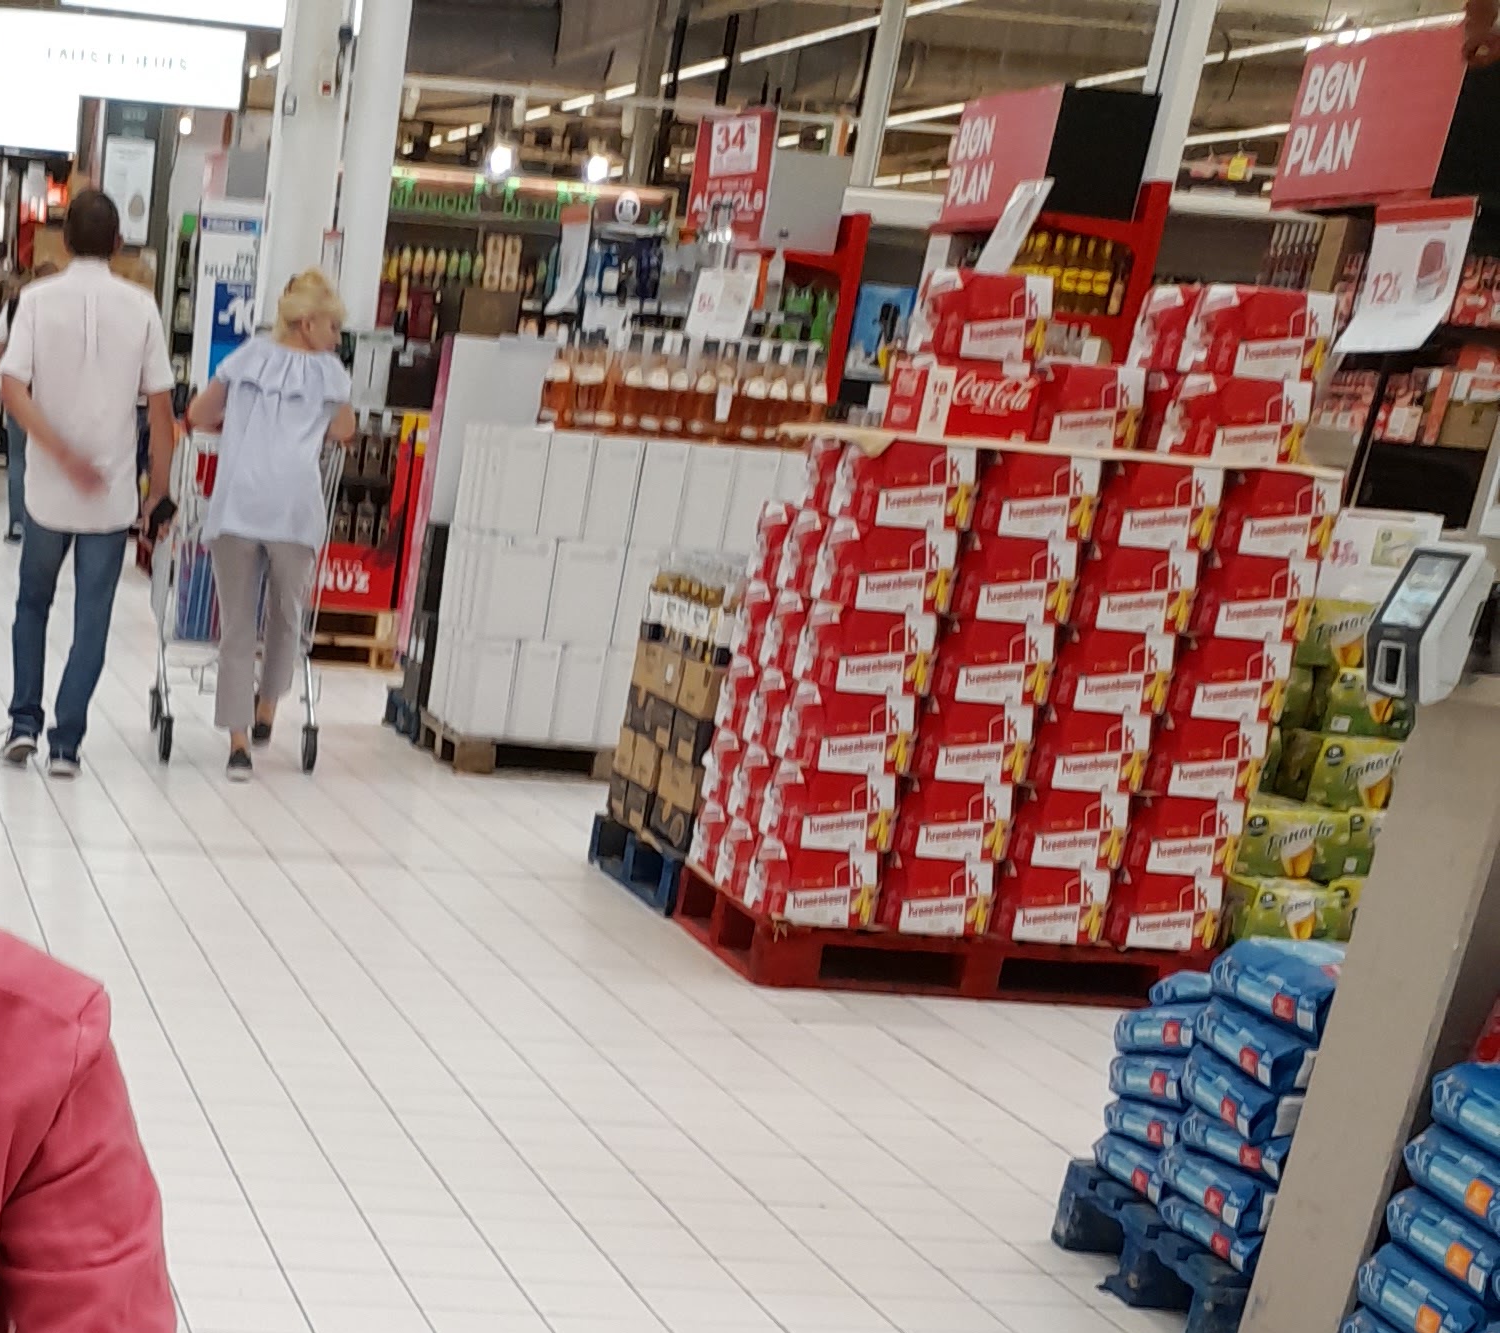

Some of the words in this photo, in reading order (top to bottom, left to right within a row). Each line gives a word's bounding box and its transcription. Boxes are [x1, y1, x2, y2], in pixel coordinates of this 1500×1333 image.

[1299, 56, 1368, 117] BON
[956, 114, 997, 162] BON
[1284, 117, 1361, 178] PLAN
[946, 160, 995, 208] PLAN
